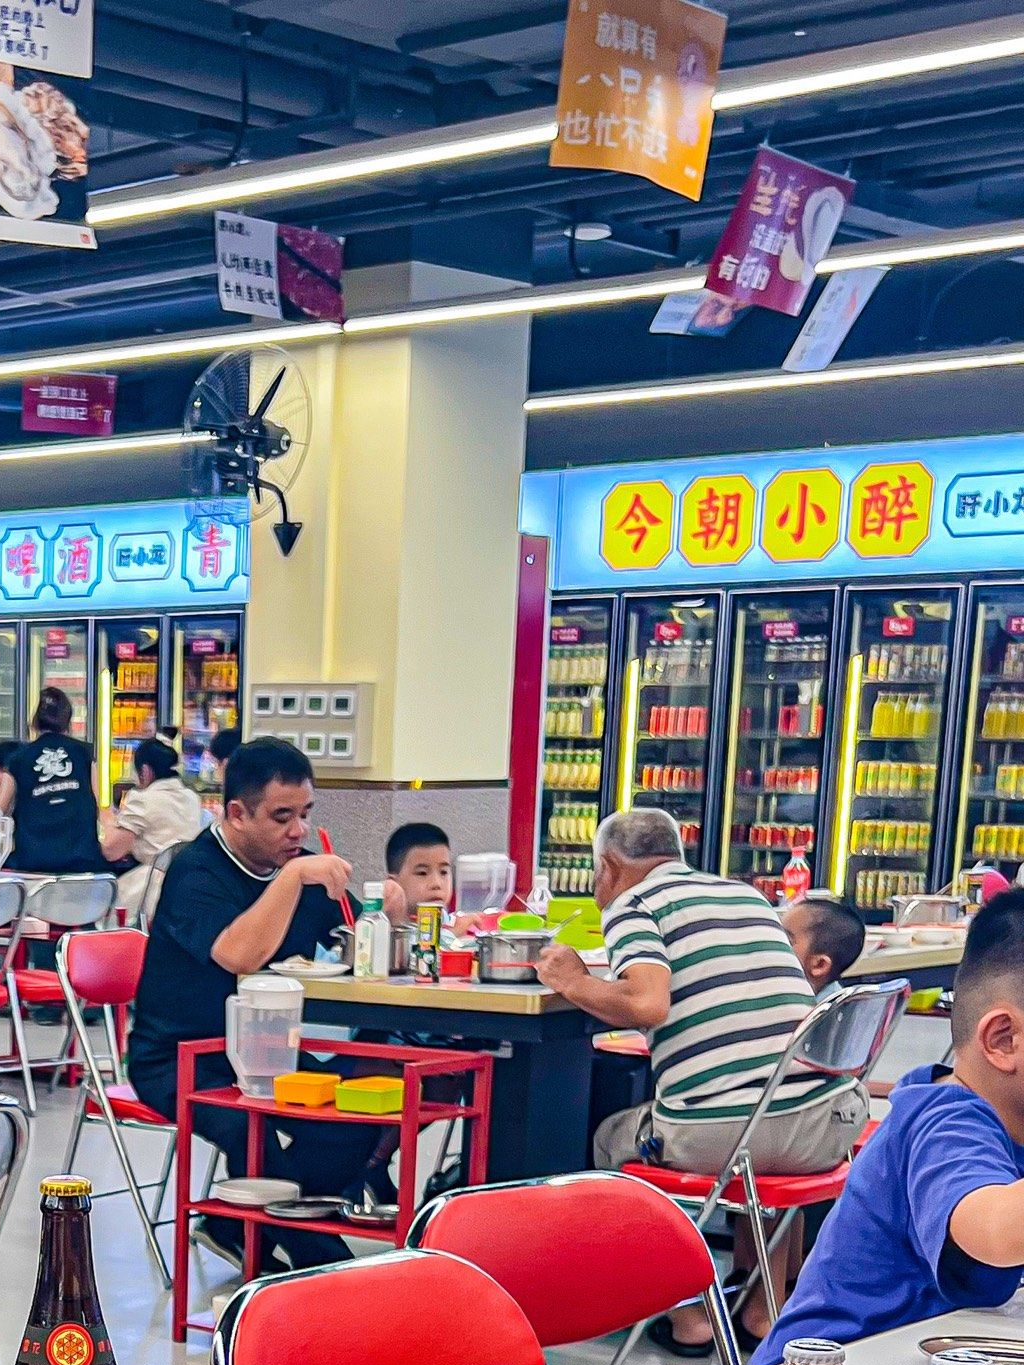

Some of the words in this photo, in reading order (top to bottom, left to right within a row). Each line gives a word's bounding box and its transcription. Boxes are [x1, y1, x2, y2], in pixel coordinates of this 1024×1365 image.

[614, 475, 919, 553] 今朝小醉
[193, 523, 231, 578] 青
